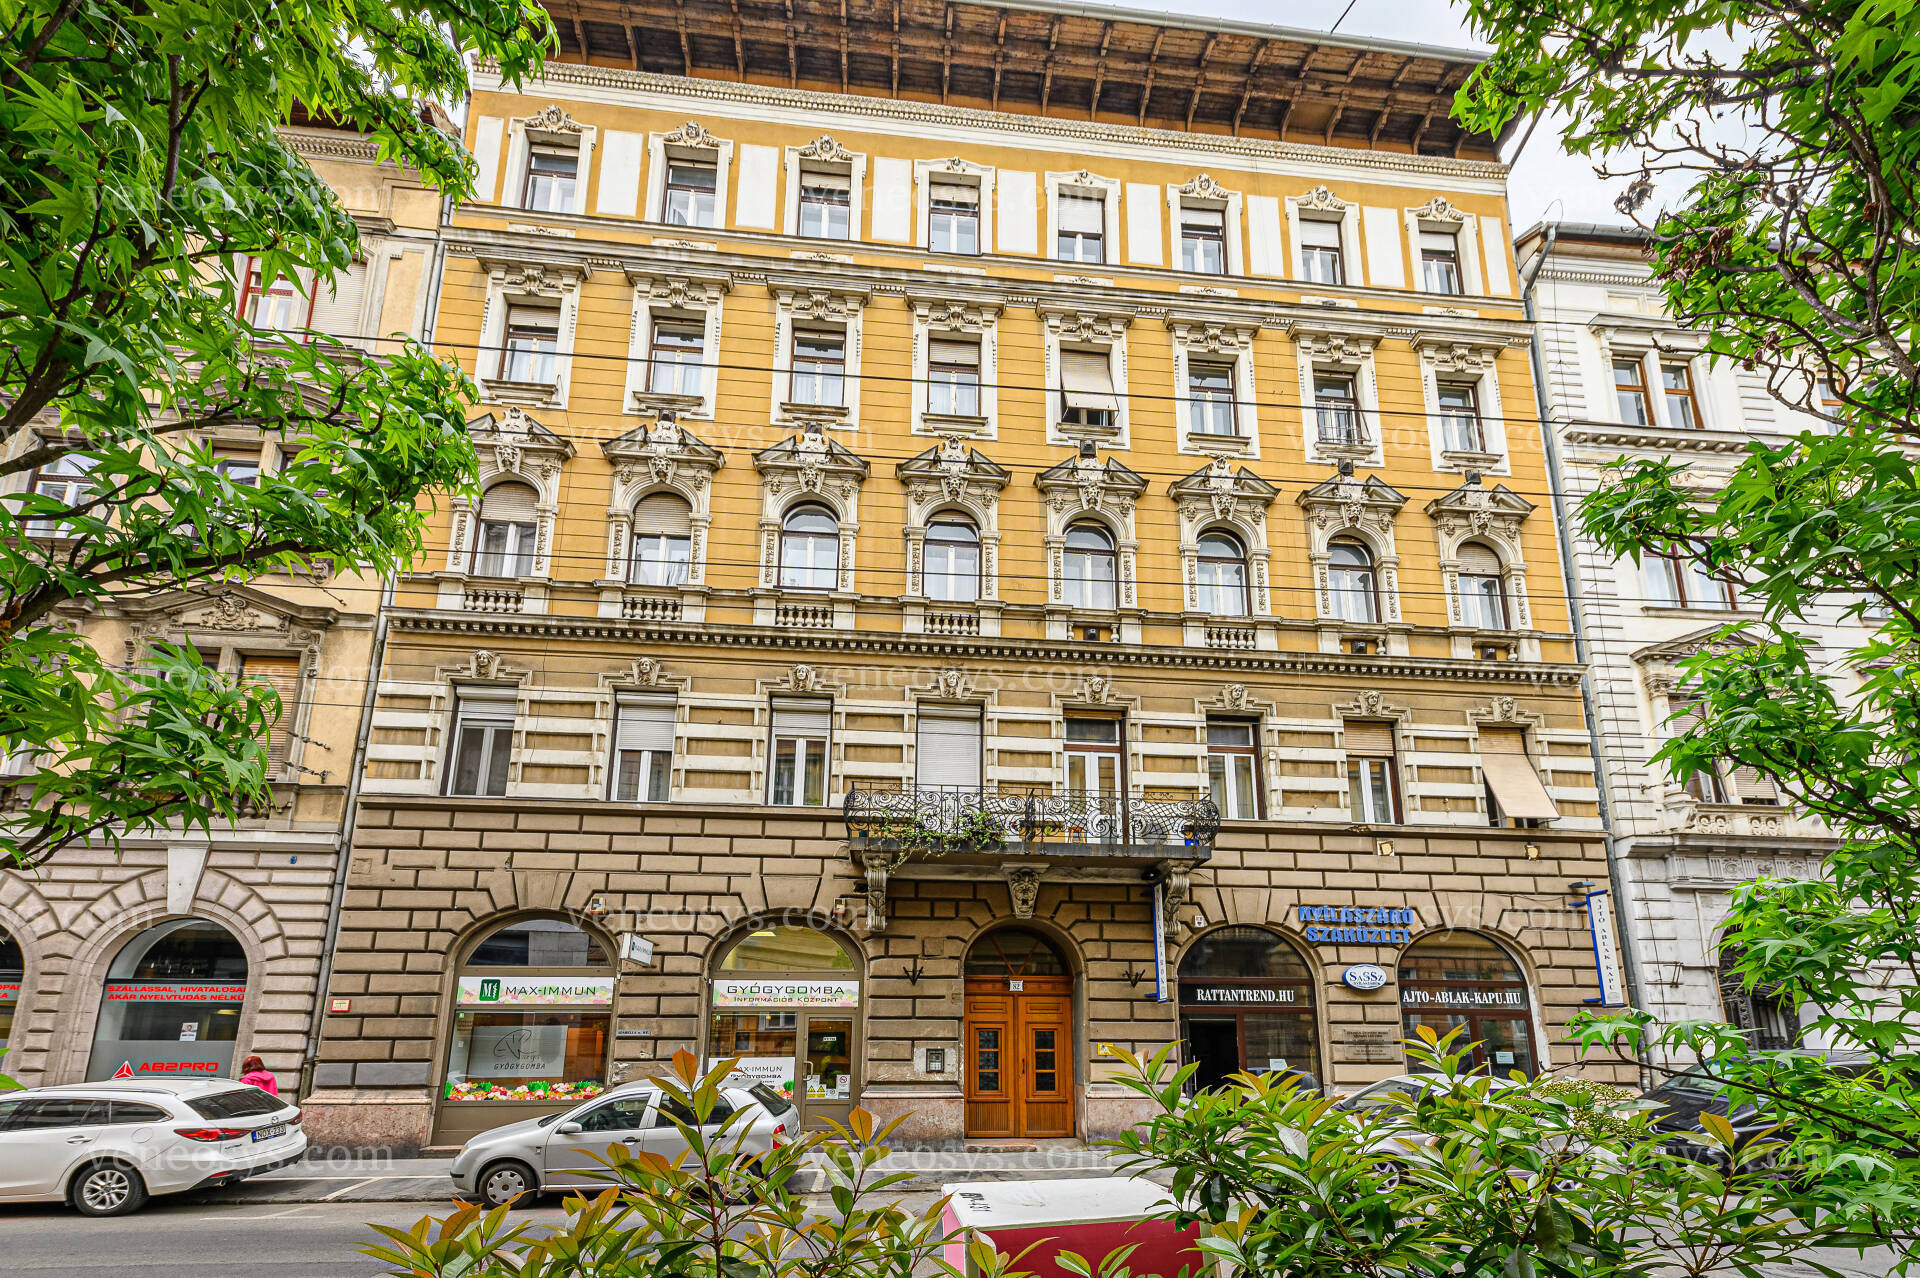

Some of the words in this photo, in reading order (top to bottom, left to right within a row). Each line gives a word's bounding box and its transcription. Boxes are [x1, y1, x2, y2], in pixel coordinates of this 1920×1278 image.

[1298, 904, 1415, 925] NYÍLÁSZÁRÓ
[1306, 926, 1411, 944] SZAKÜZLET
[505, 986, 597, 996] MAX-IMMUN
[727, 982, 845, 994] GYÓGYGOMBA
[1196, 988, 1295, 1002] RATTANTREND.HU
[1402, 990, 1521, 1004] AJTO-ABLAK-KAPU.HU
[138, 1062, 219, 1072] AB2PRO
[493, 1061, 546, 1070] GYÓGYGOMBA
